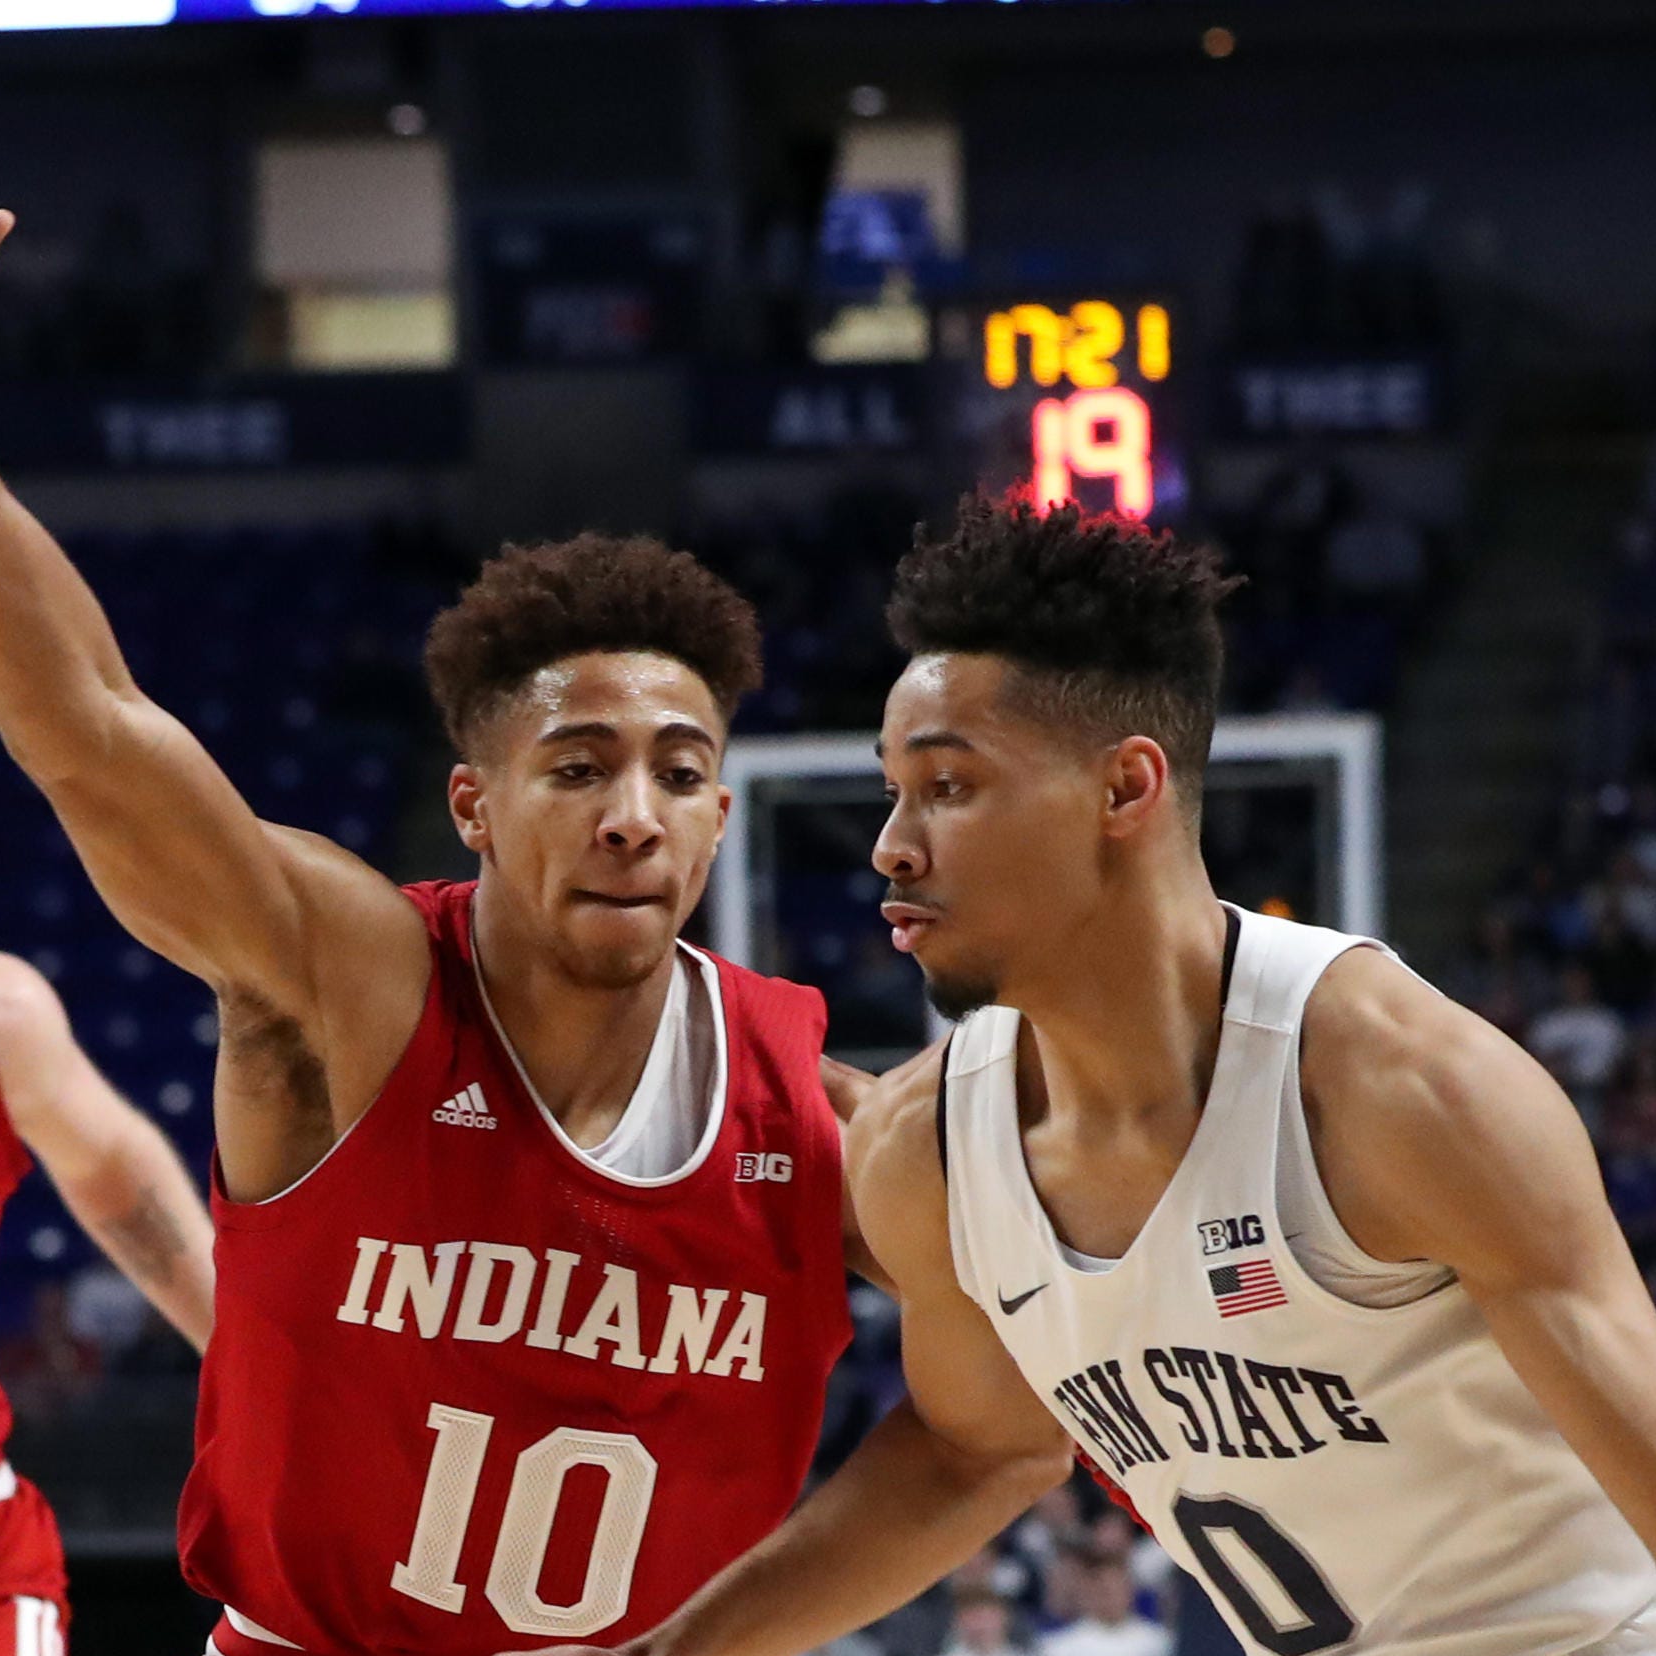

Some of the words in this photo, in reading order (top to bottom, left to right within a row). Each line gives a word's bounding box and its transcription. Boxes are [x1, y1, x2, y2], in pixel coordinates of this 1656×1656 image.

[1032, 386, 1153, 521] 19
[431, 1105, 498, 1131] adidas
[336, 1236, 768, 1382] INDIANA
[1053, 1359, 1171, 1477] ENN
[1143, 1346, 1390, 1460] STATE
[390, 1401, 659, 1638] 10
